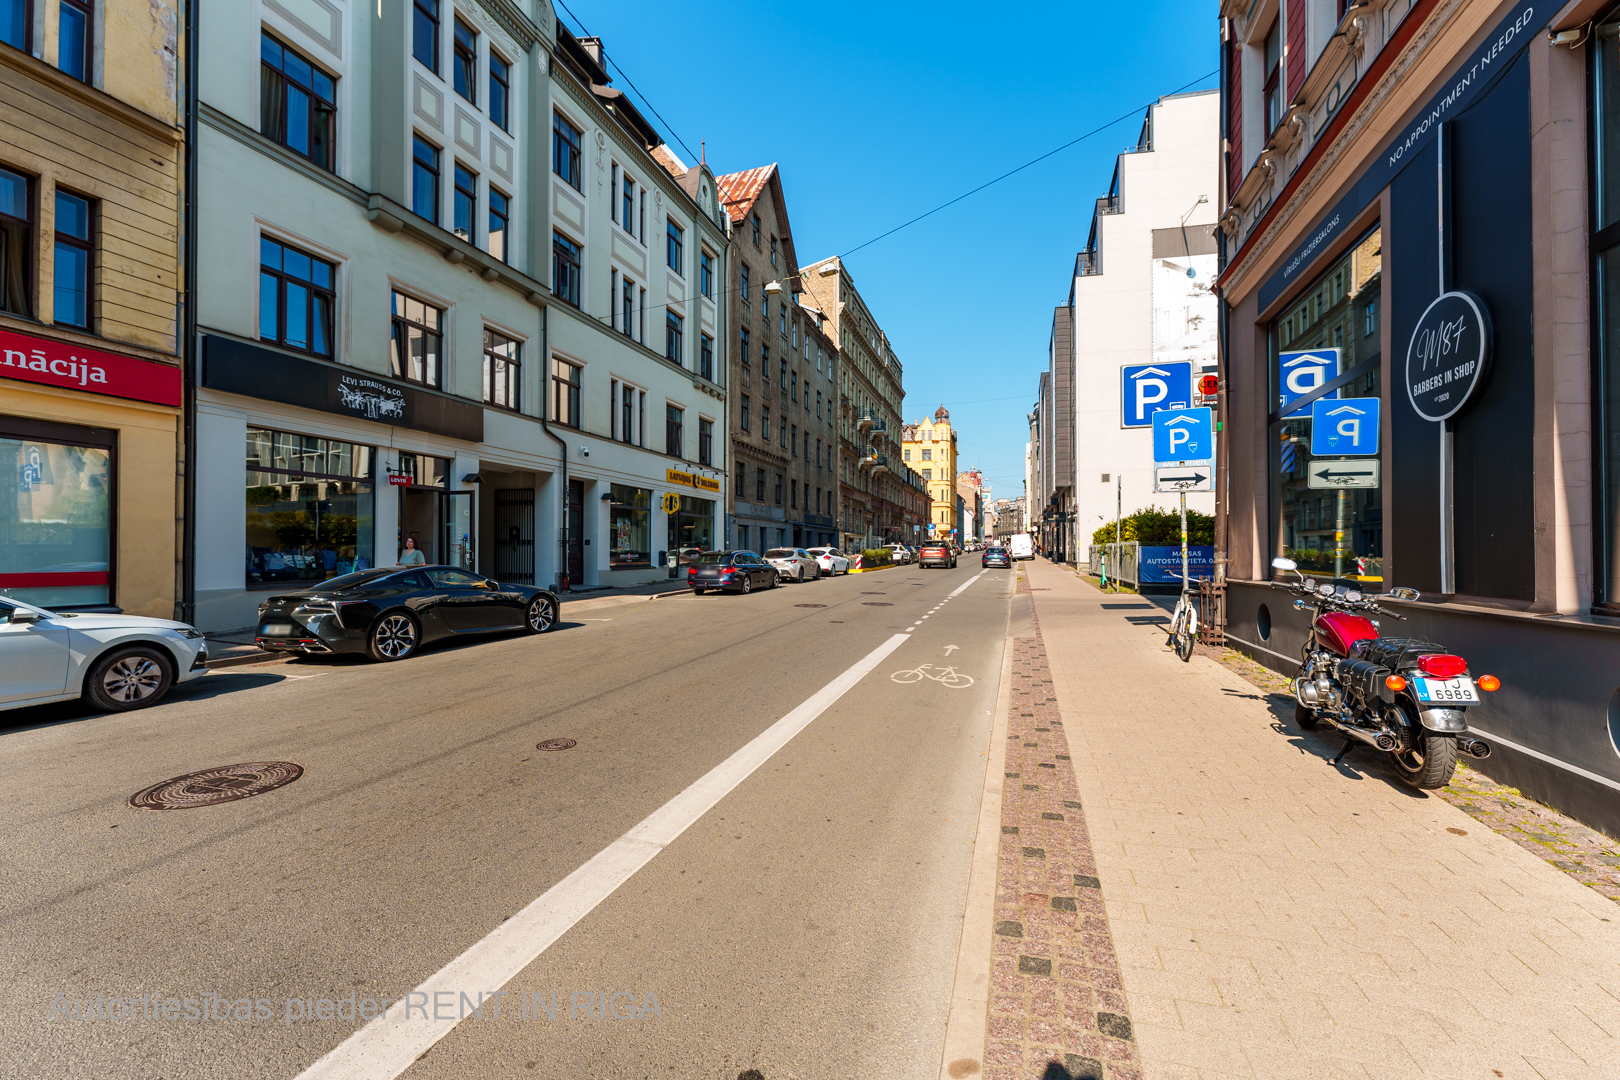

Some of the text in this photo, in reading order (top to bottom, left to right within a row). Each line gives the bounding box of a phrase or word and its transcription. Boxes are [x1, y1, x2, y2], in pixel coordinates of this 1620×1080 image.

[1389, 7, 1534, 167] NO APPOINTMENT NEEDED
[1416, 314, 1467, 372] M87
[0, 349, 108, 386] nācija
[342, 375, 358, 386] LEVI
[359, 379, 386, 393] STRAUSS
[392, 388, 403, 397] CO.
[1413, 360, 1475, 397] BARBERS IN SHOP
[1136, 378, 1168, 420] P
[1169, 428, 1190, 454] P
[1435, 689, 1472, 700] 6989
